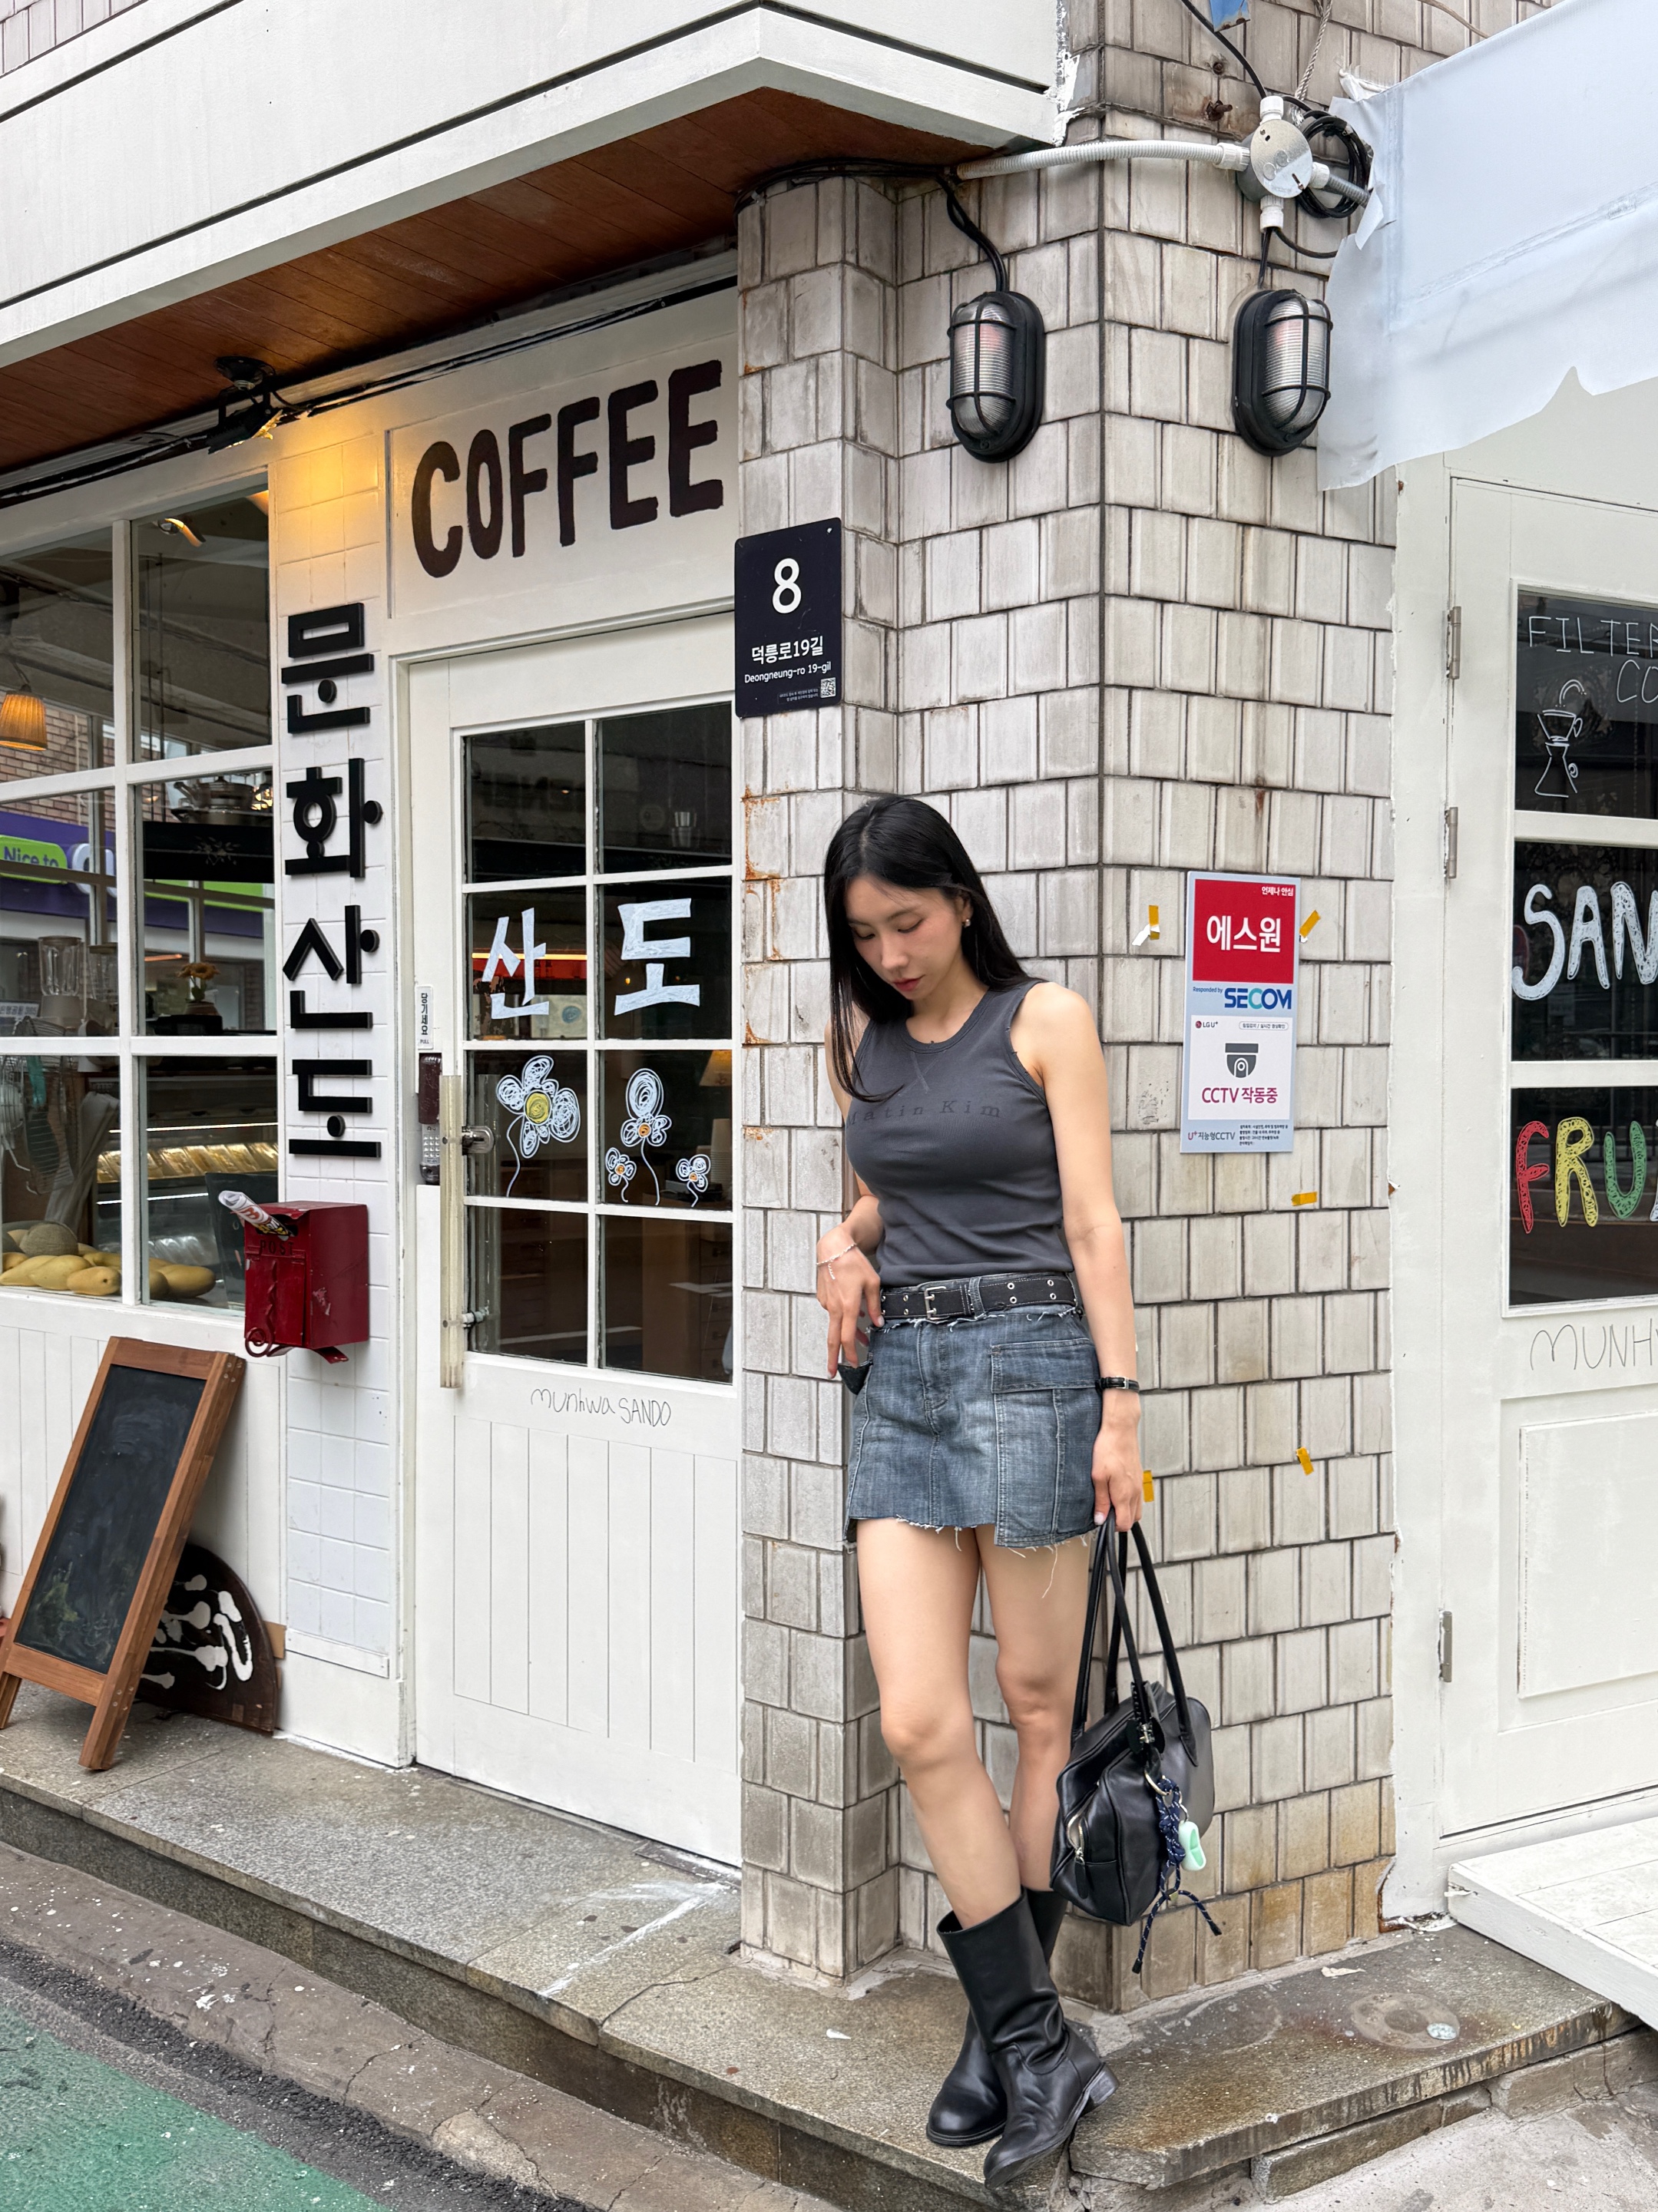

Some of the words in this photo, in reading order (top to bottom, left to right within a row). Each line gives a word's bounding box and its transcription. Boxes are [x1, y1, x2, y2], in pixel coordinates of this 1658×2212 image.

[412, 359, 723, 578] COFFEE
[773, 557, 802, 614] 8
[752, 636, 823, 664] 덕릉로19길
[745, 666, 806, 683] Deongneung-ro
[808, 661, 831, 674] 19-gil
[281, 602, 383, 1158] 문화산도
[1262, 887, 1280, 896] 언제나
[1281, 888, 1293, 897] 안심
[1206, 915, 1281, 953] 에스원
[1224, 987, 1292, 1010] SECOM
[1202, 1087, 1239, 1103] CCTV
[1242, 1086, 1278, 1103] 작동중
[846, 1106, 924, 1129] Matin
[941, 1100, 1001, 1118] Kim
[1515, 1116, 1658, 1234] FRU
[260, 1239, 293, 1255] POST
[619, 1397, 671, 1427] SANDO
